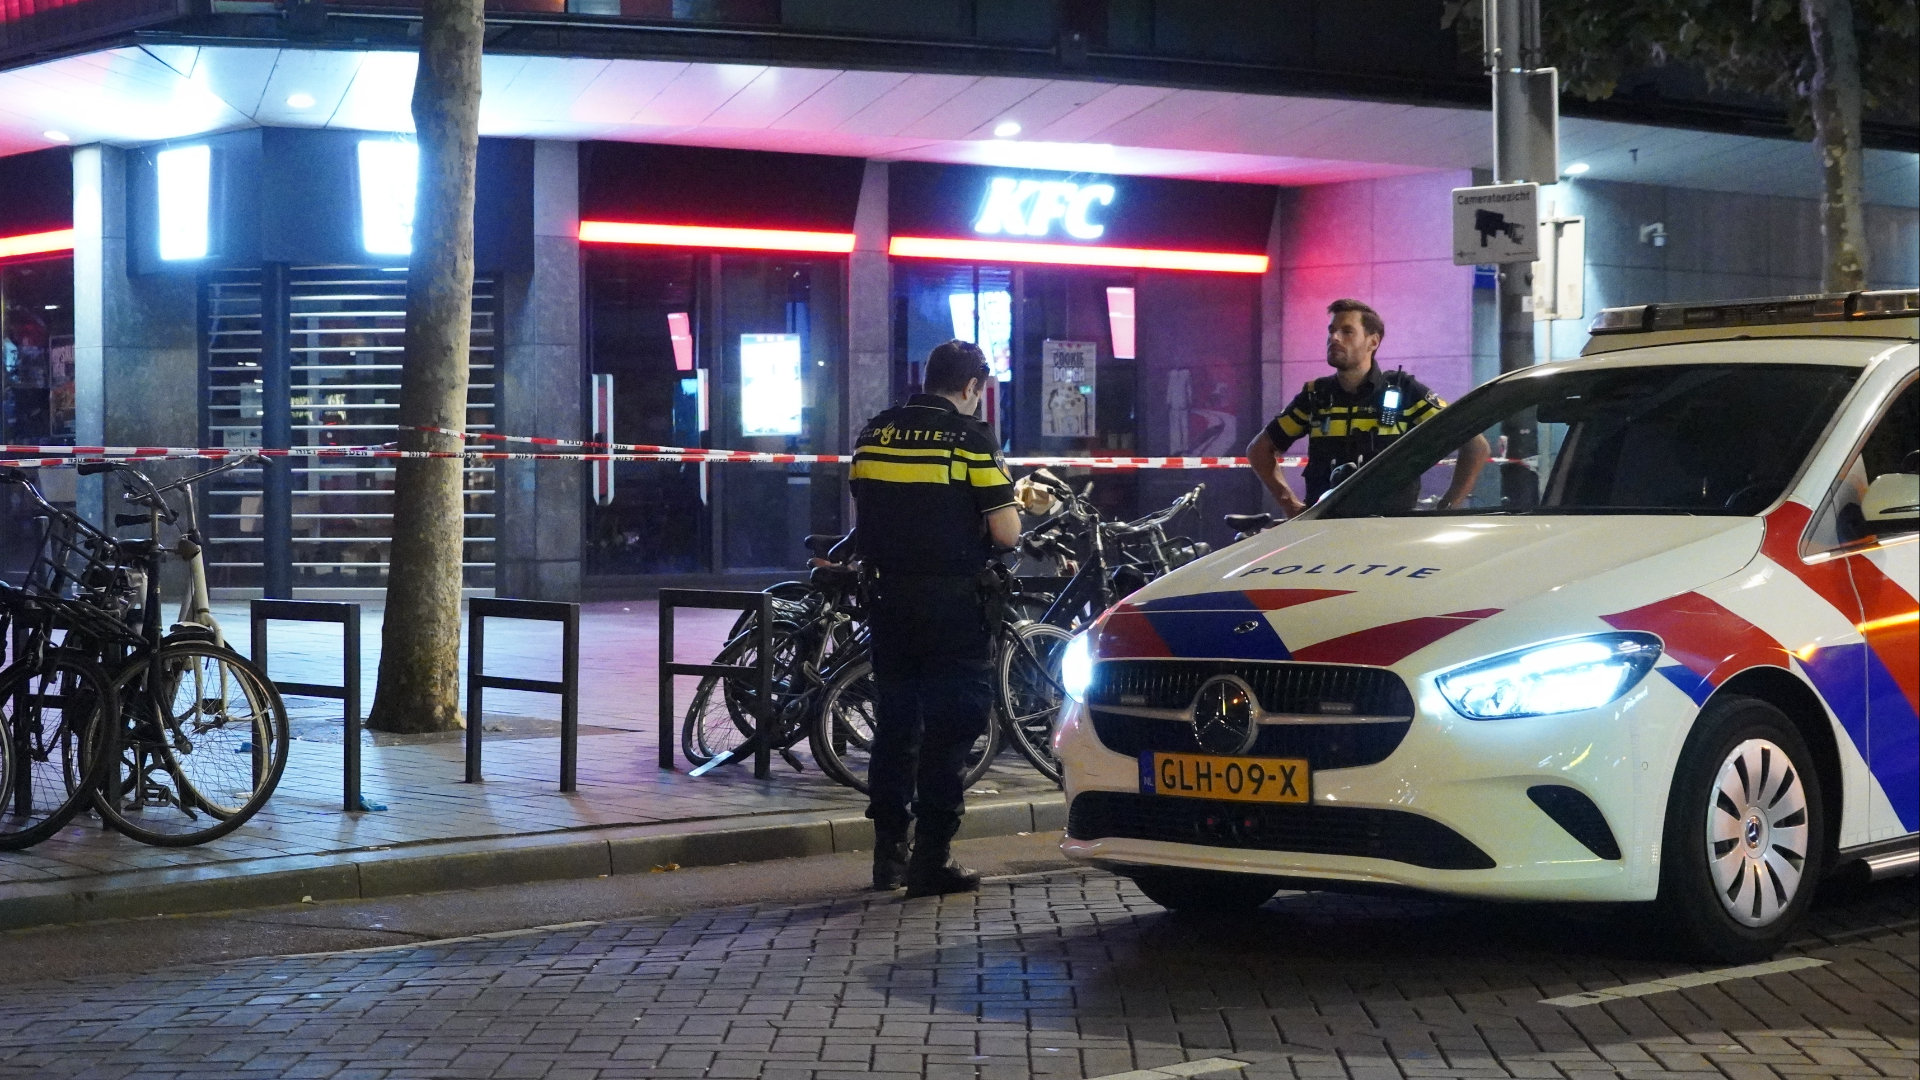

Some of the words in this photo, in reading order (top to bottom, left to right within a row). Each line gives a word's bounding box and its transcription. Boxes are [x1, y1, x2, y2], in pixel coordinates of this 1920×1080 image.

[974, 177, 1115, 239] KFC
[1053, 352, 1084, 367] COOKIE
[1239, 563, 1442, 579] POLITIE
[1143, 776, 1154, 787] NL
[1161, 758, 1299, 797] GLH-09-X
